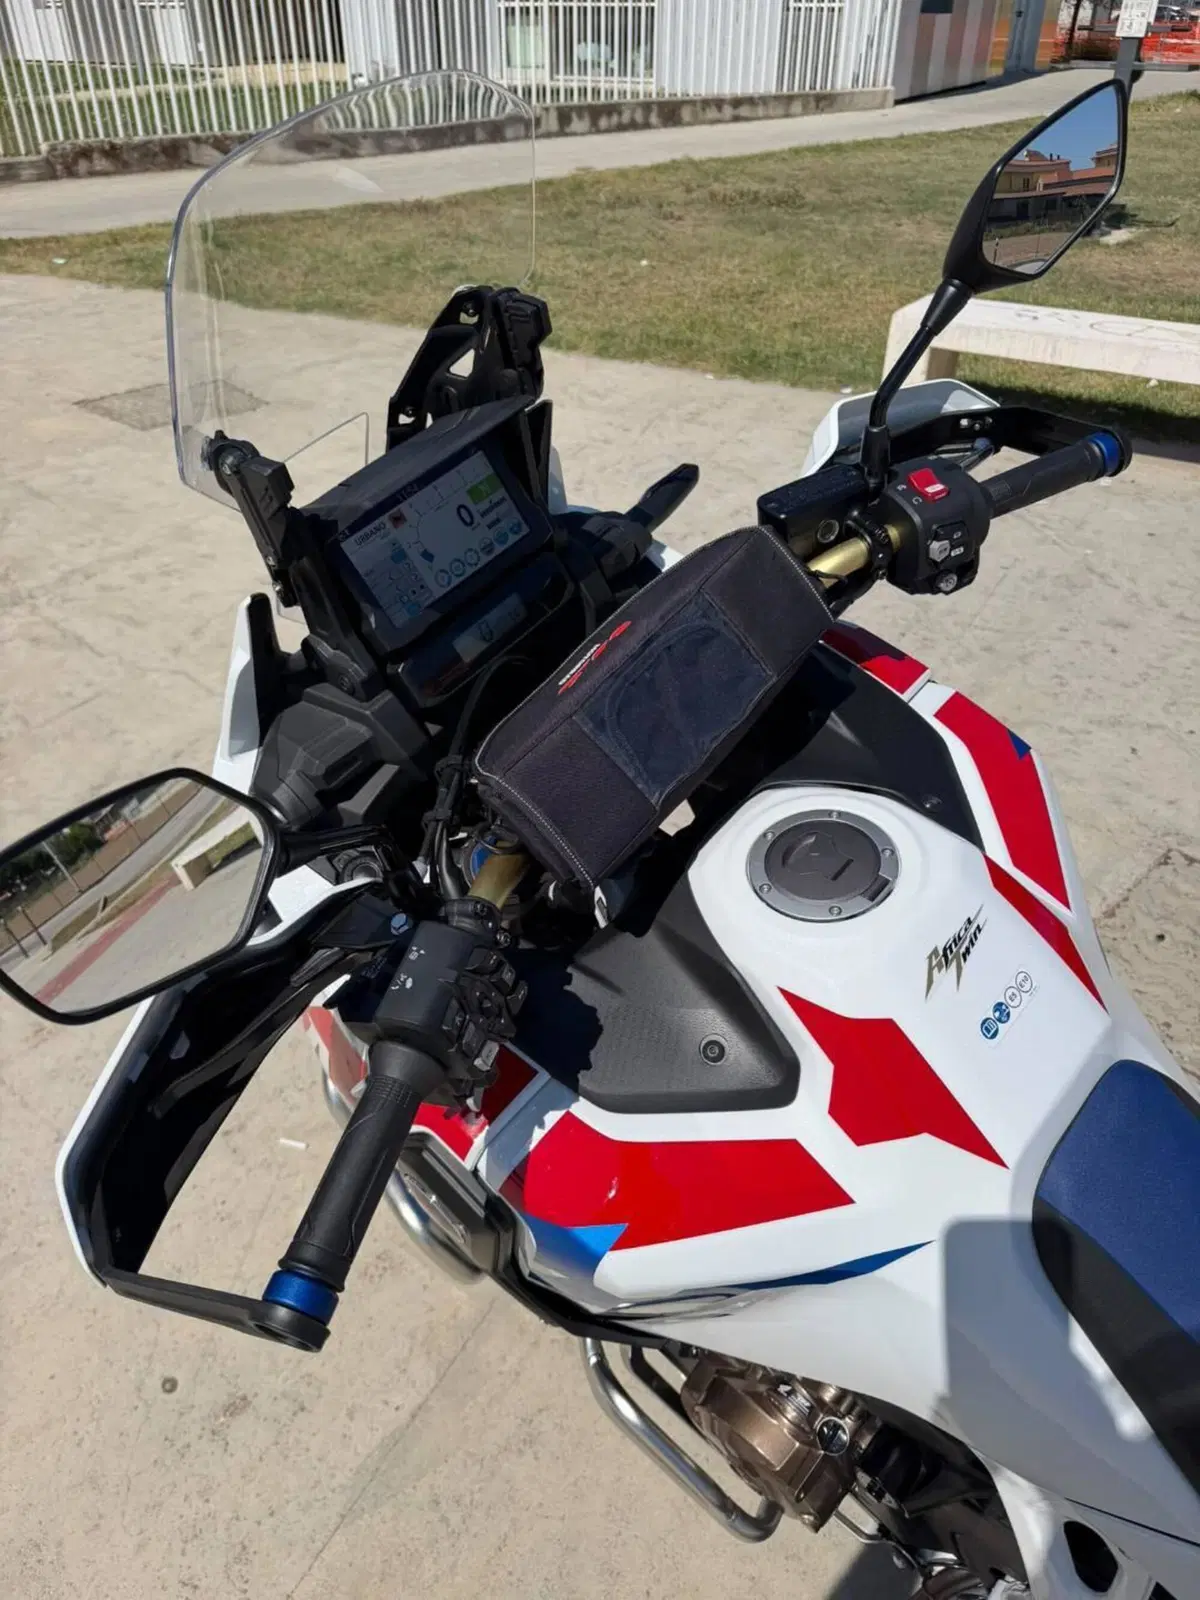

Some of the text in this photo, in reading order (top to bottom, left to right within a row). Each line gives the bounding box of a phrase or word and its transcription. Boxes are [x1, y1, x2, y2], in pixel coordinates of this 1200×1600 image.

[457, 504, 474, 527] 0
[355, 522, 386, 546] URBANO
[1019, 975, 1028, 989] E10
[1008, 992, 1018, 1003] E5
